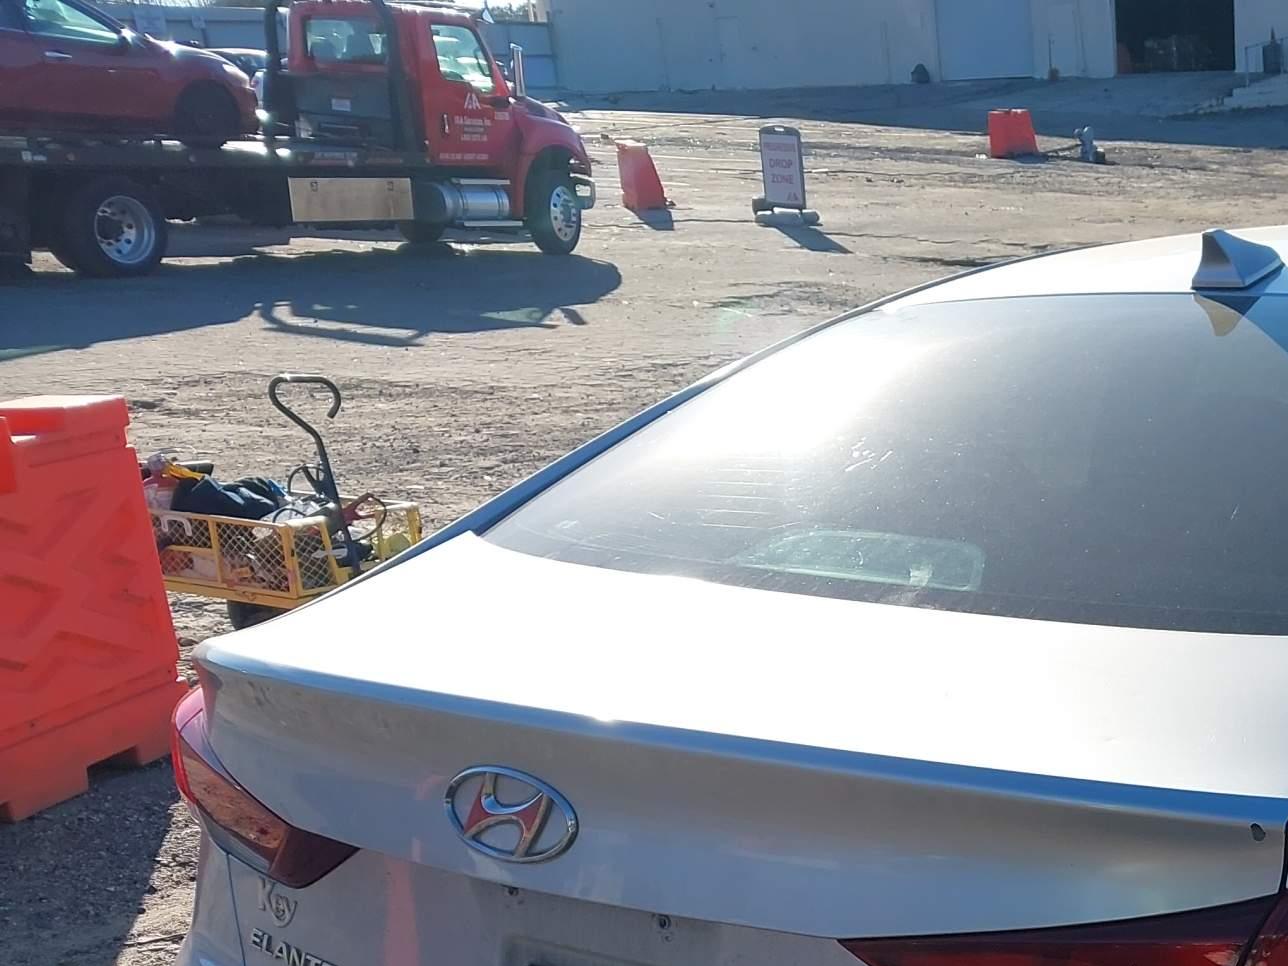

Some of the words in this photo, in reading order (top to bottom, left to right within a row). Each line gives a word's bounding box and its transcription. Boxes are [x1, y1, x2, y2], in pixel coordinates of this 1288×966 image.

[768, 158, 793, 169] DROP
[771, 173, 794, 185] ZONE
[257, 876, 299, 929] Key
